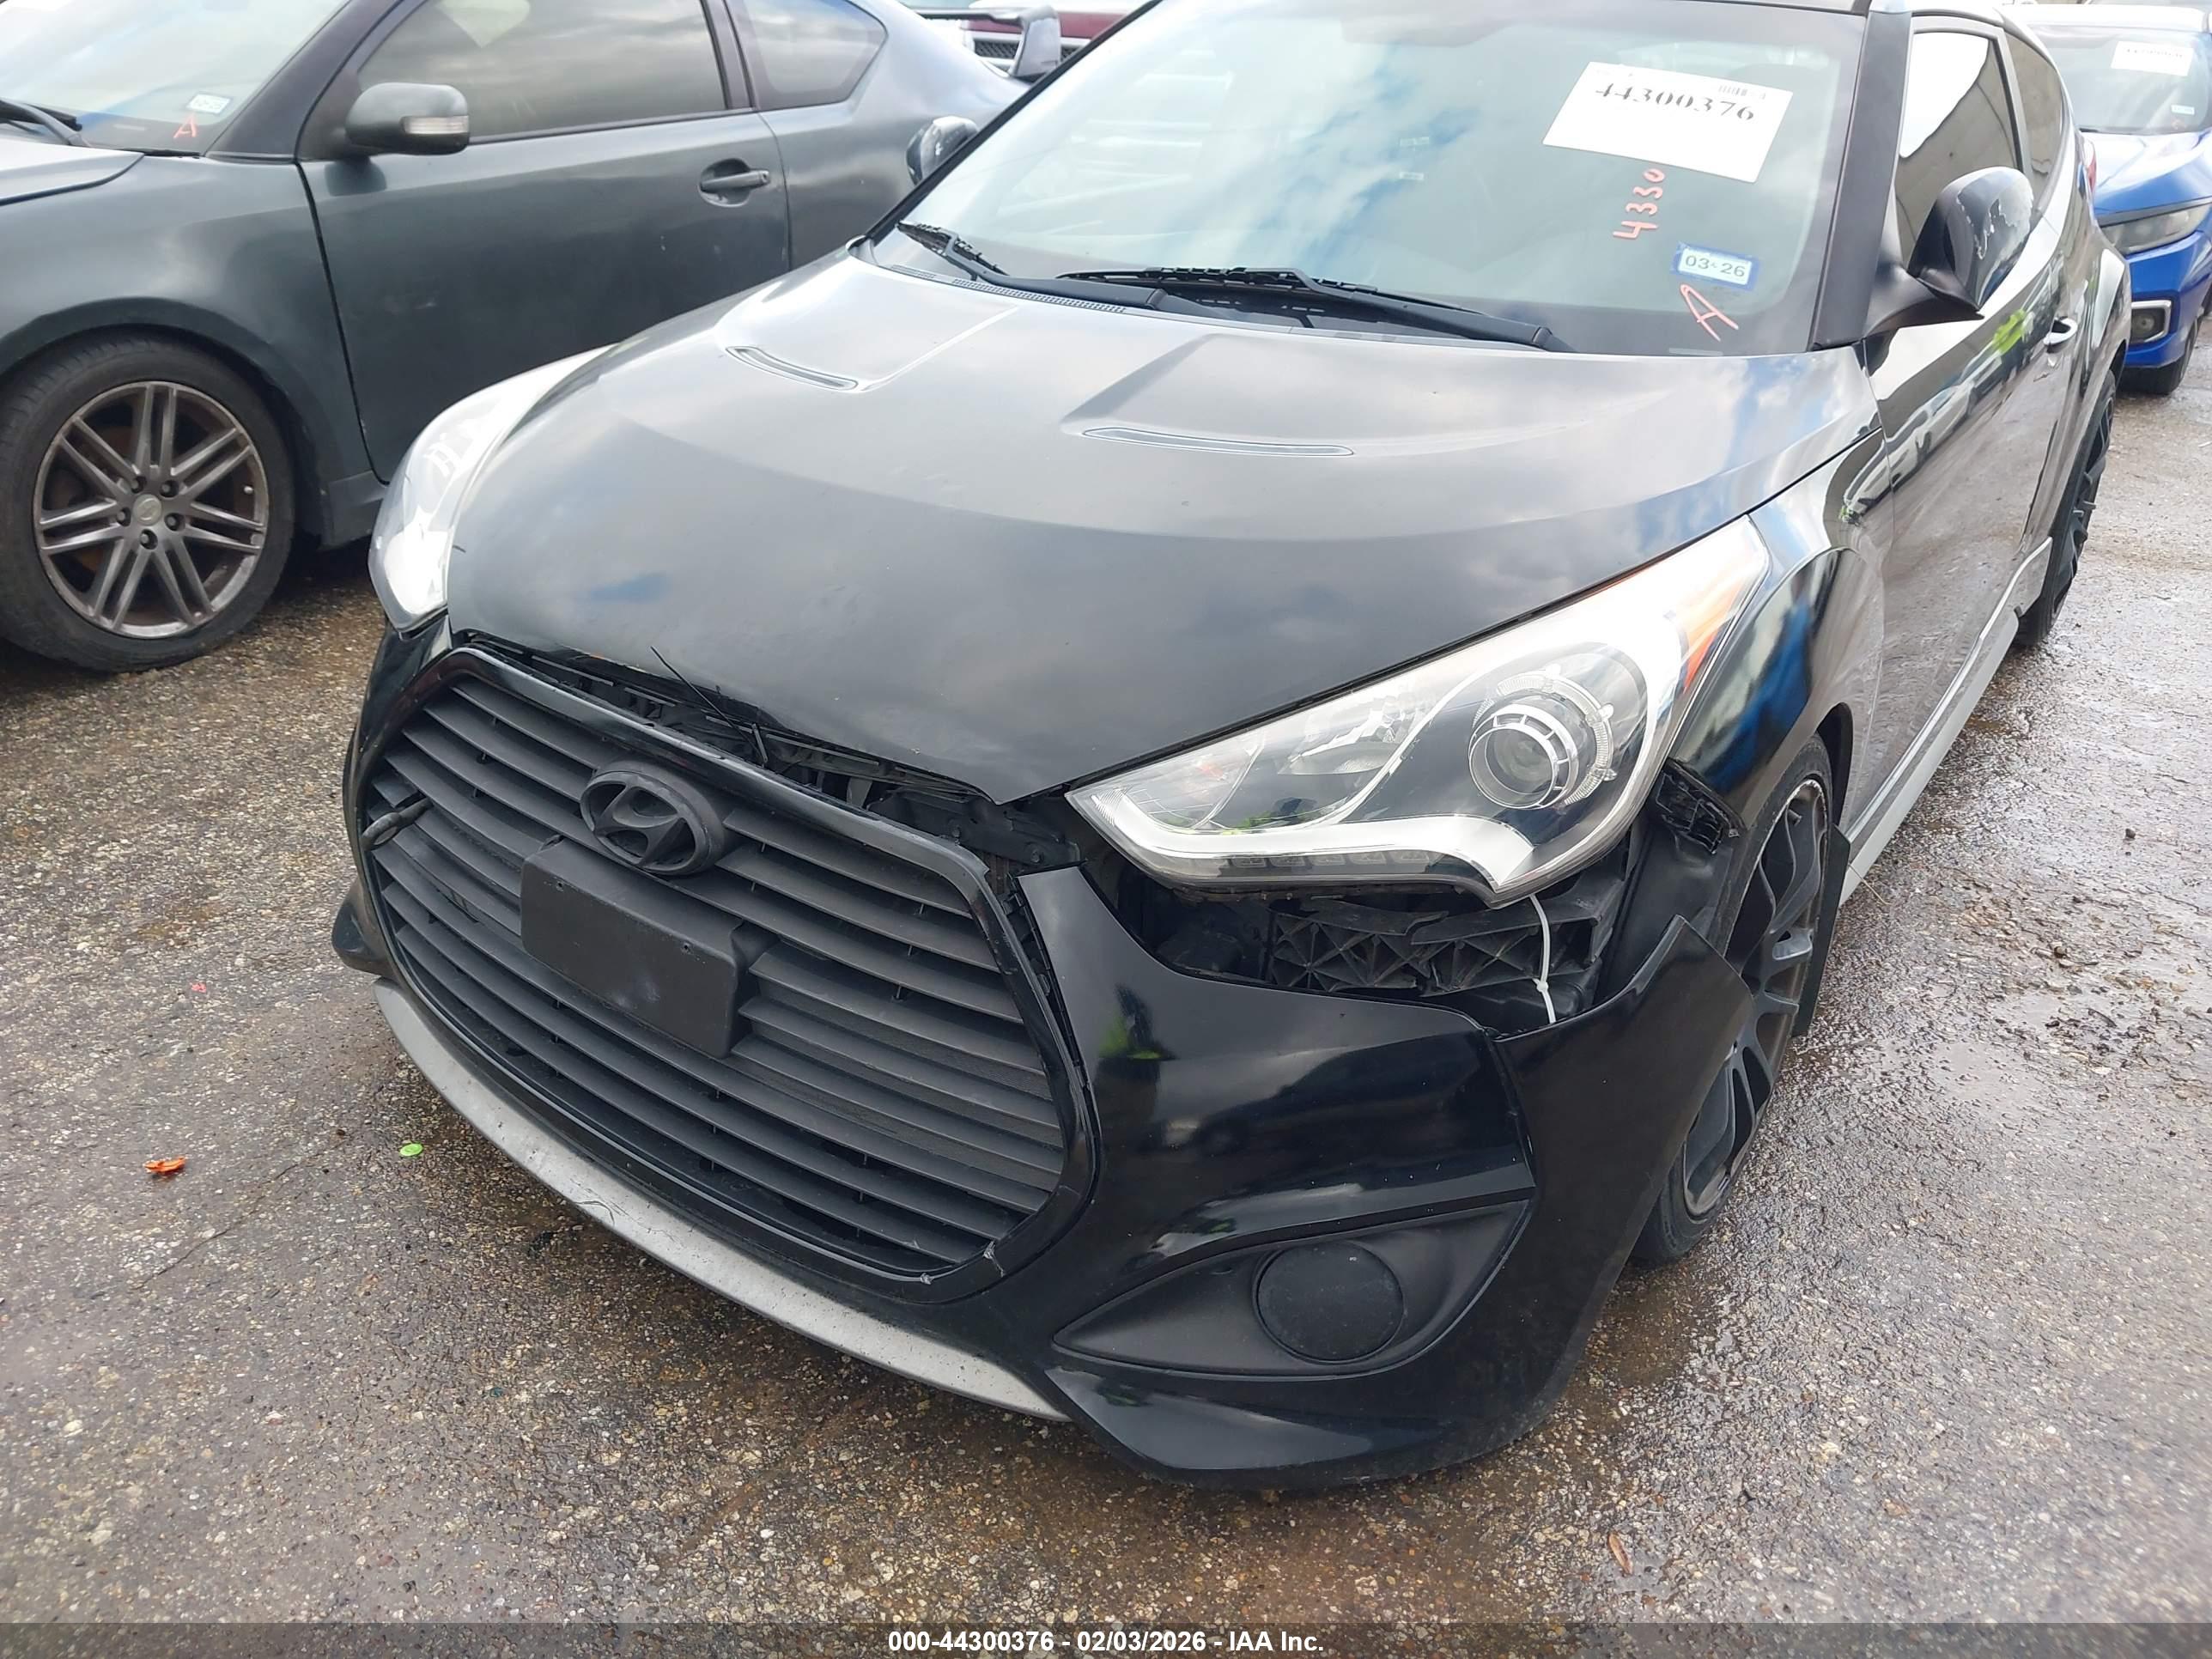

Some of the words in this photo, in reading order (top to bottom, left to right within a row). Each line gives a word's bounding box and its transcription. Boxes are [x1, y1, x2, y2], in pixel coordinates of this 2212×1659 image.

[1595, 82, 1754, 120] 44300376
[173, 113, 198, 138] A
[1686, 255, 1711, 270] 03
[1720, 263, 1746, 277] 26
[1680, 284, 1739, 342] A
